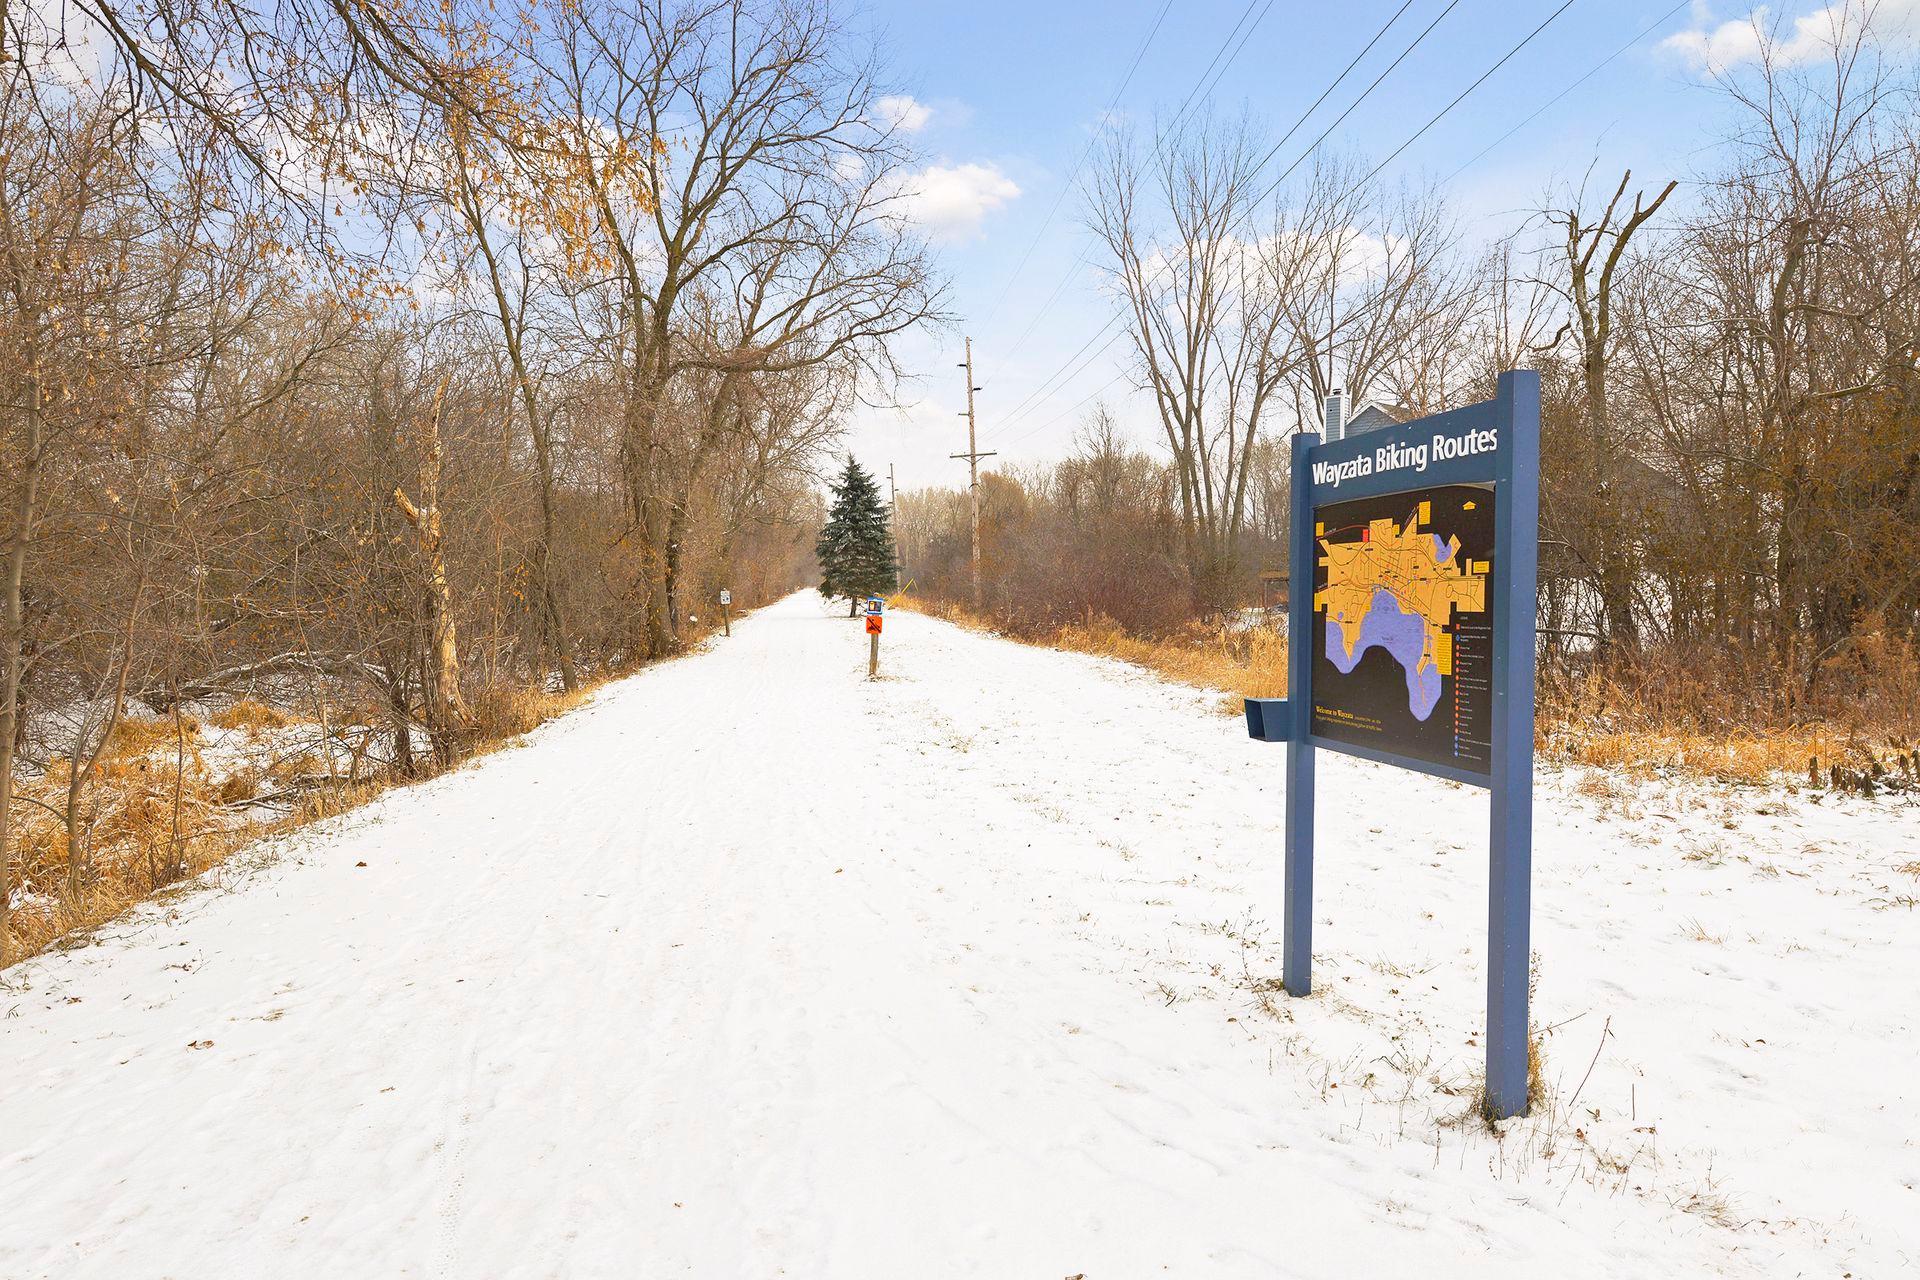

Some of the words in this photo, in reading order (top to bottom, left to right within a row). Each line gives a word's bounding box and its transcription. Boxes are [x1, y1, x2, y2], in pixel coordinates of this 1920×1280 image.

[1312, 454, 1372, 488] Wayzata
[1375, 441, 1428, 472] Biking
[1432, 428, 1498, 462] Routes
